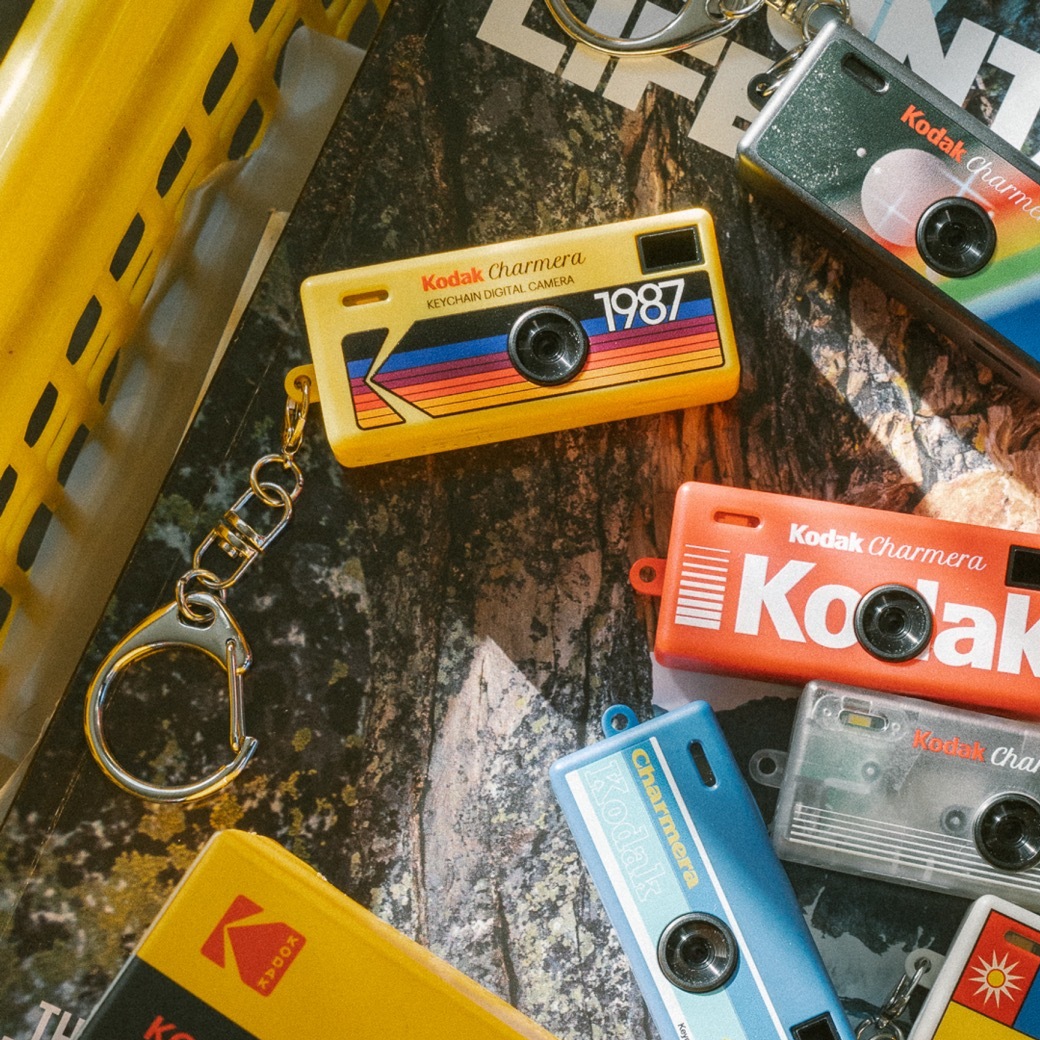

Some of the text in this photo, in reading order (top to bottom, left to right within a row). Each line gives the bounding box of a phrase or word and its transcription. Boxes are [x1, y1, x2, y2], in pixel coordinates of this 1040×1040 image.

[900, 104, 969, 164] Kodak
[421, 251, 587, 292] Kodak Charmera
[426, 275, 574, 310] KEYCHAIN DIGITAL CAMERA
[593, 278, 686, 332] 1987
[788, 523, 987, 571] Kodak Charmera
[912, 728, 987, 762] Kodak
[584, 759, 666, 903] Kodak
[632, 748, 699, 890] Charmera
[257, 935, 299, 990] KODAK
